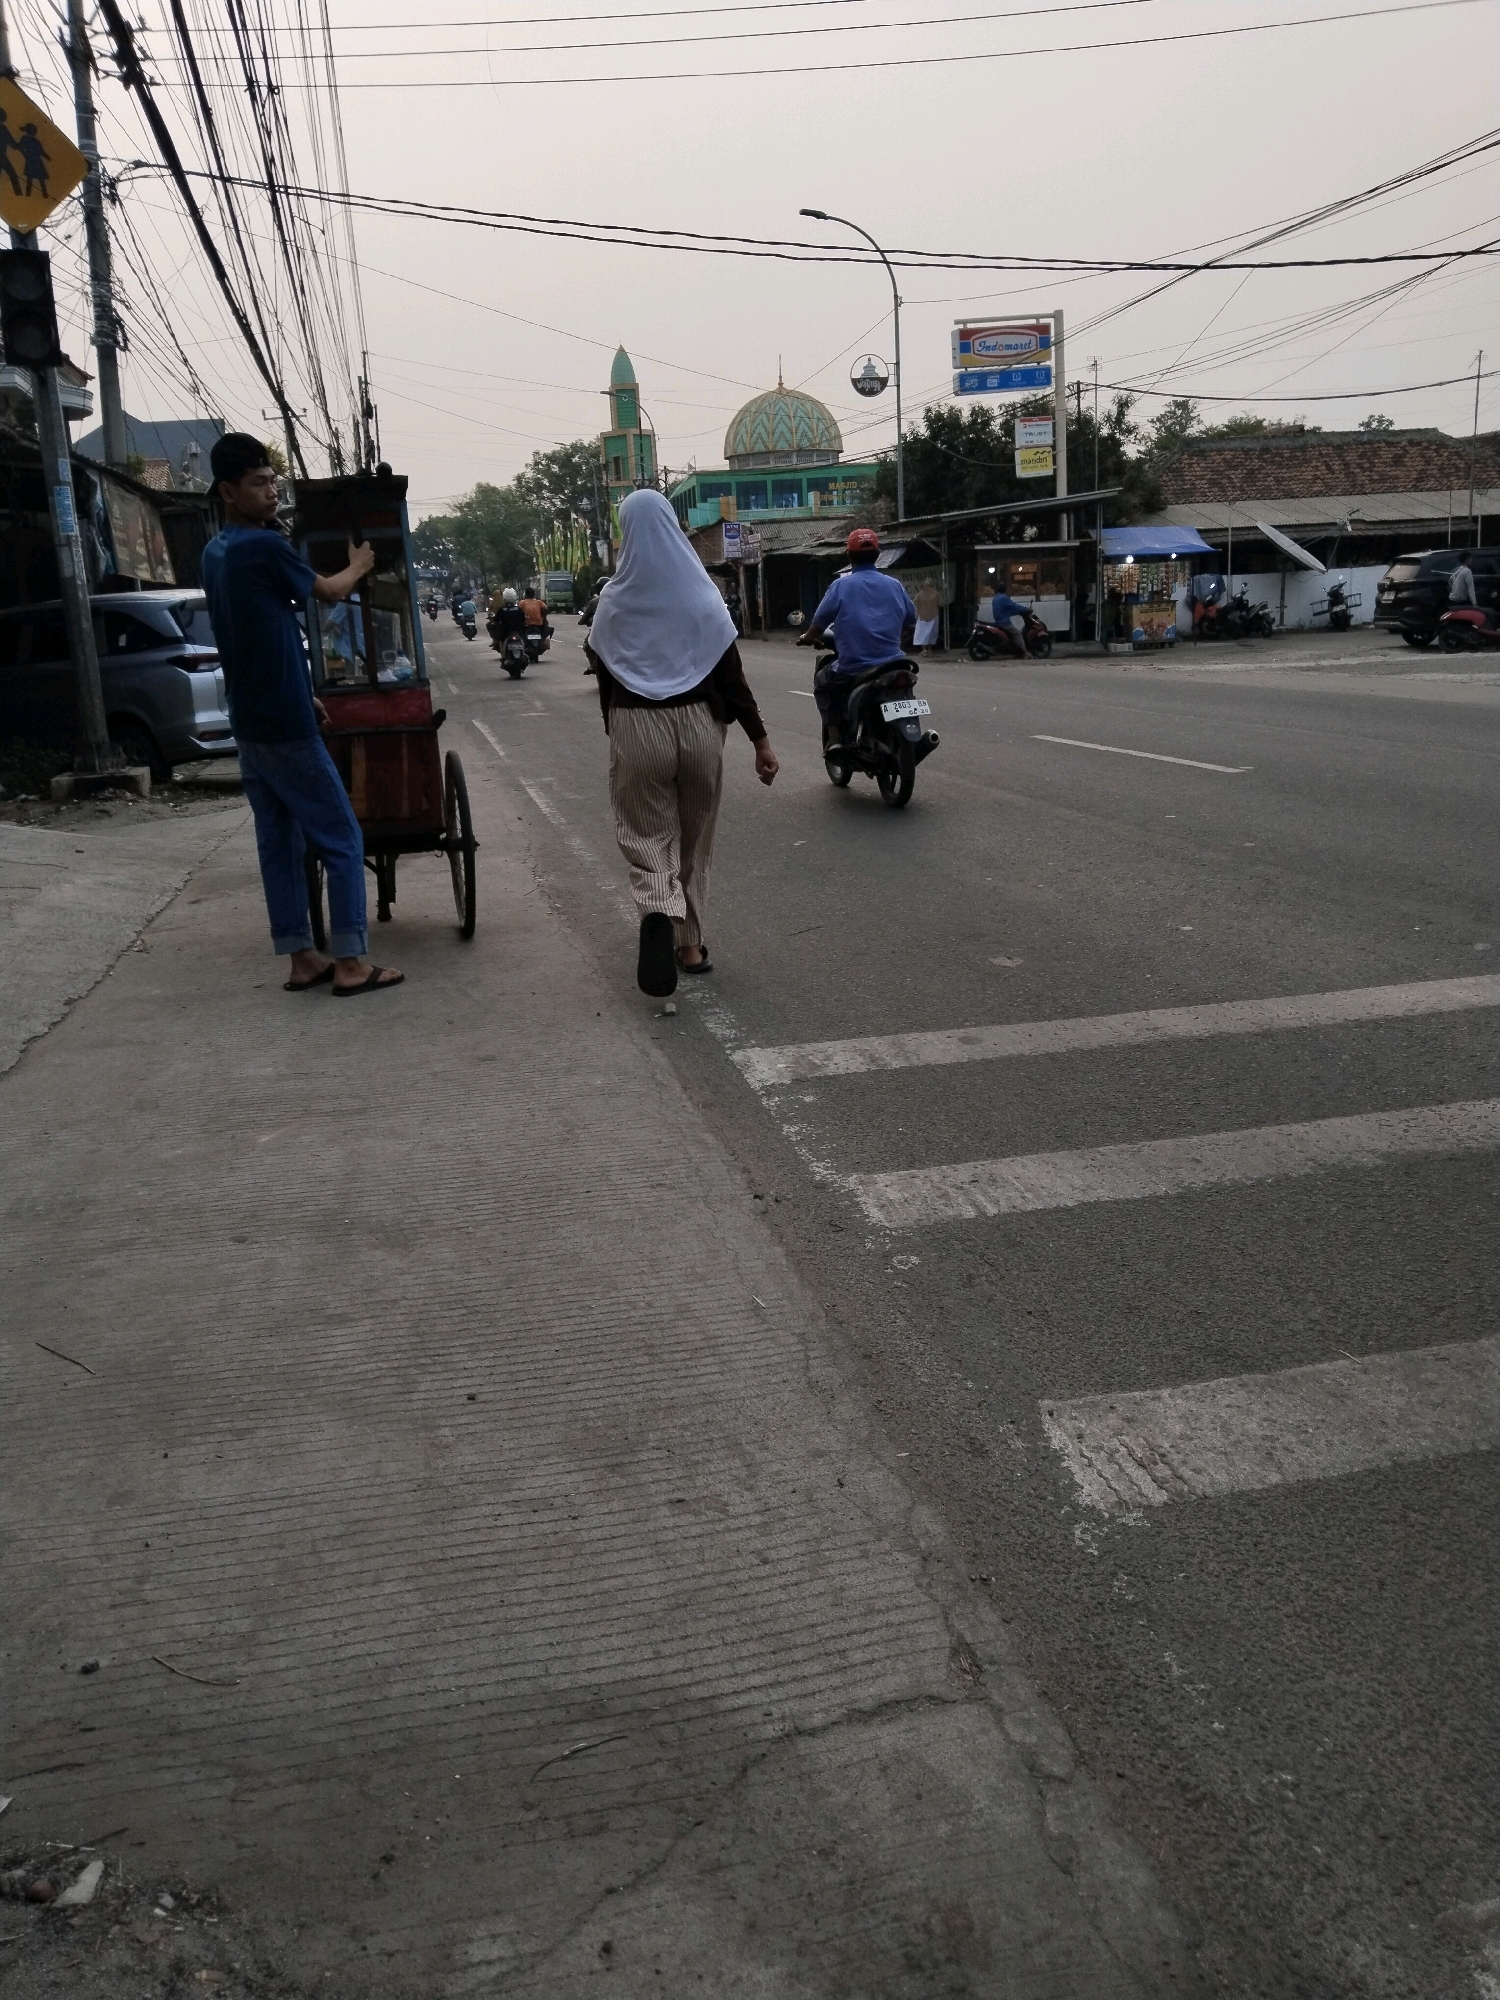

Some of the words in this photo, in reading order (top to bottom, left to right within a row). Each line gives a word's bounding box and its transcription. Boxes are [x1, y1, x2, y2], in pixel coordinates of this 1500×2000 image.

[976, 339, 1032, 353] Indomaret
[828, 481, 858, 490] MASJID
[902, 570, 938, 581] BUBUR
[883, 705, 888, 713] A
